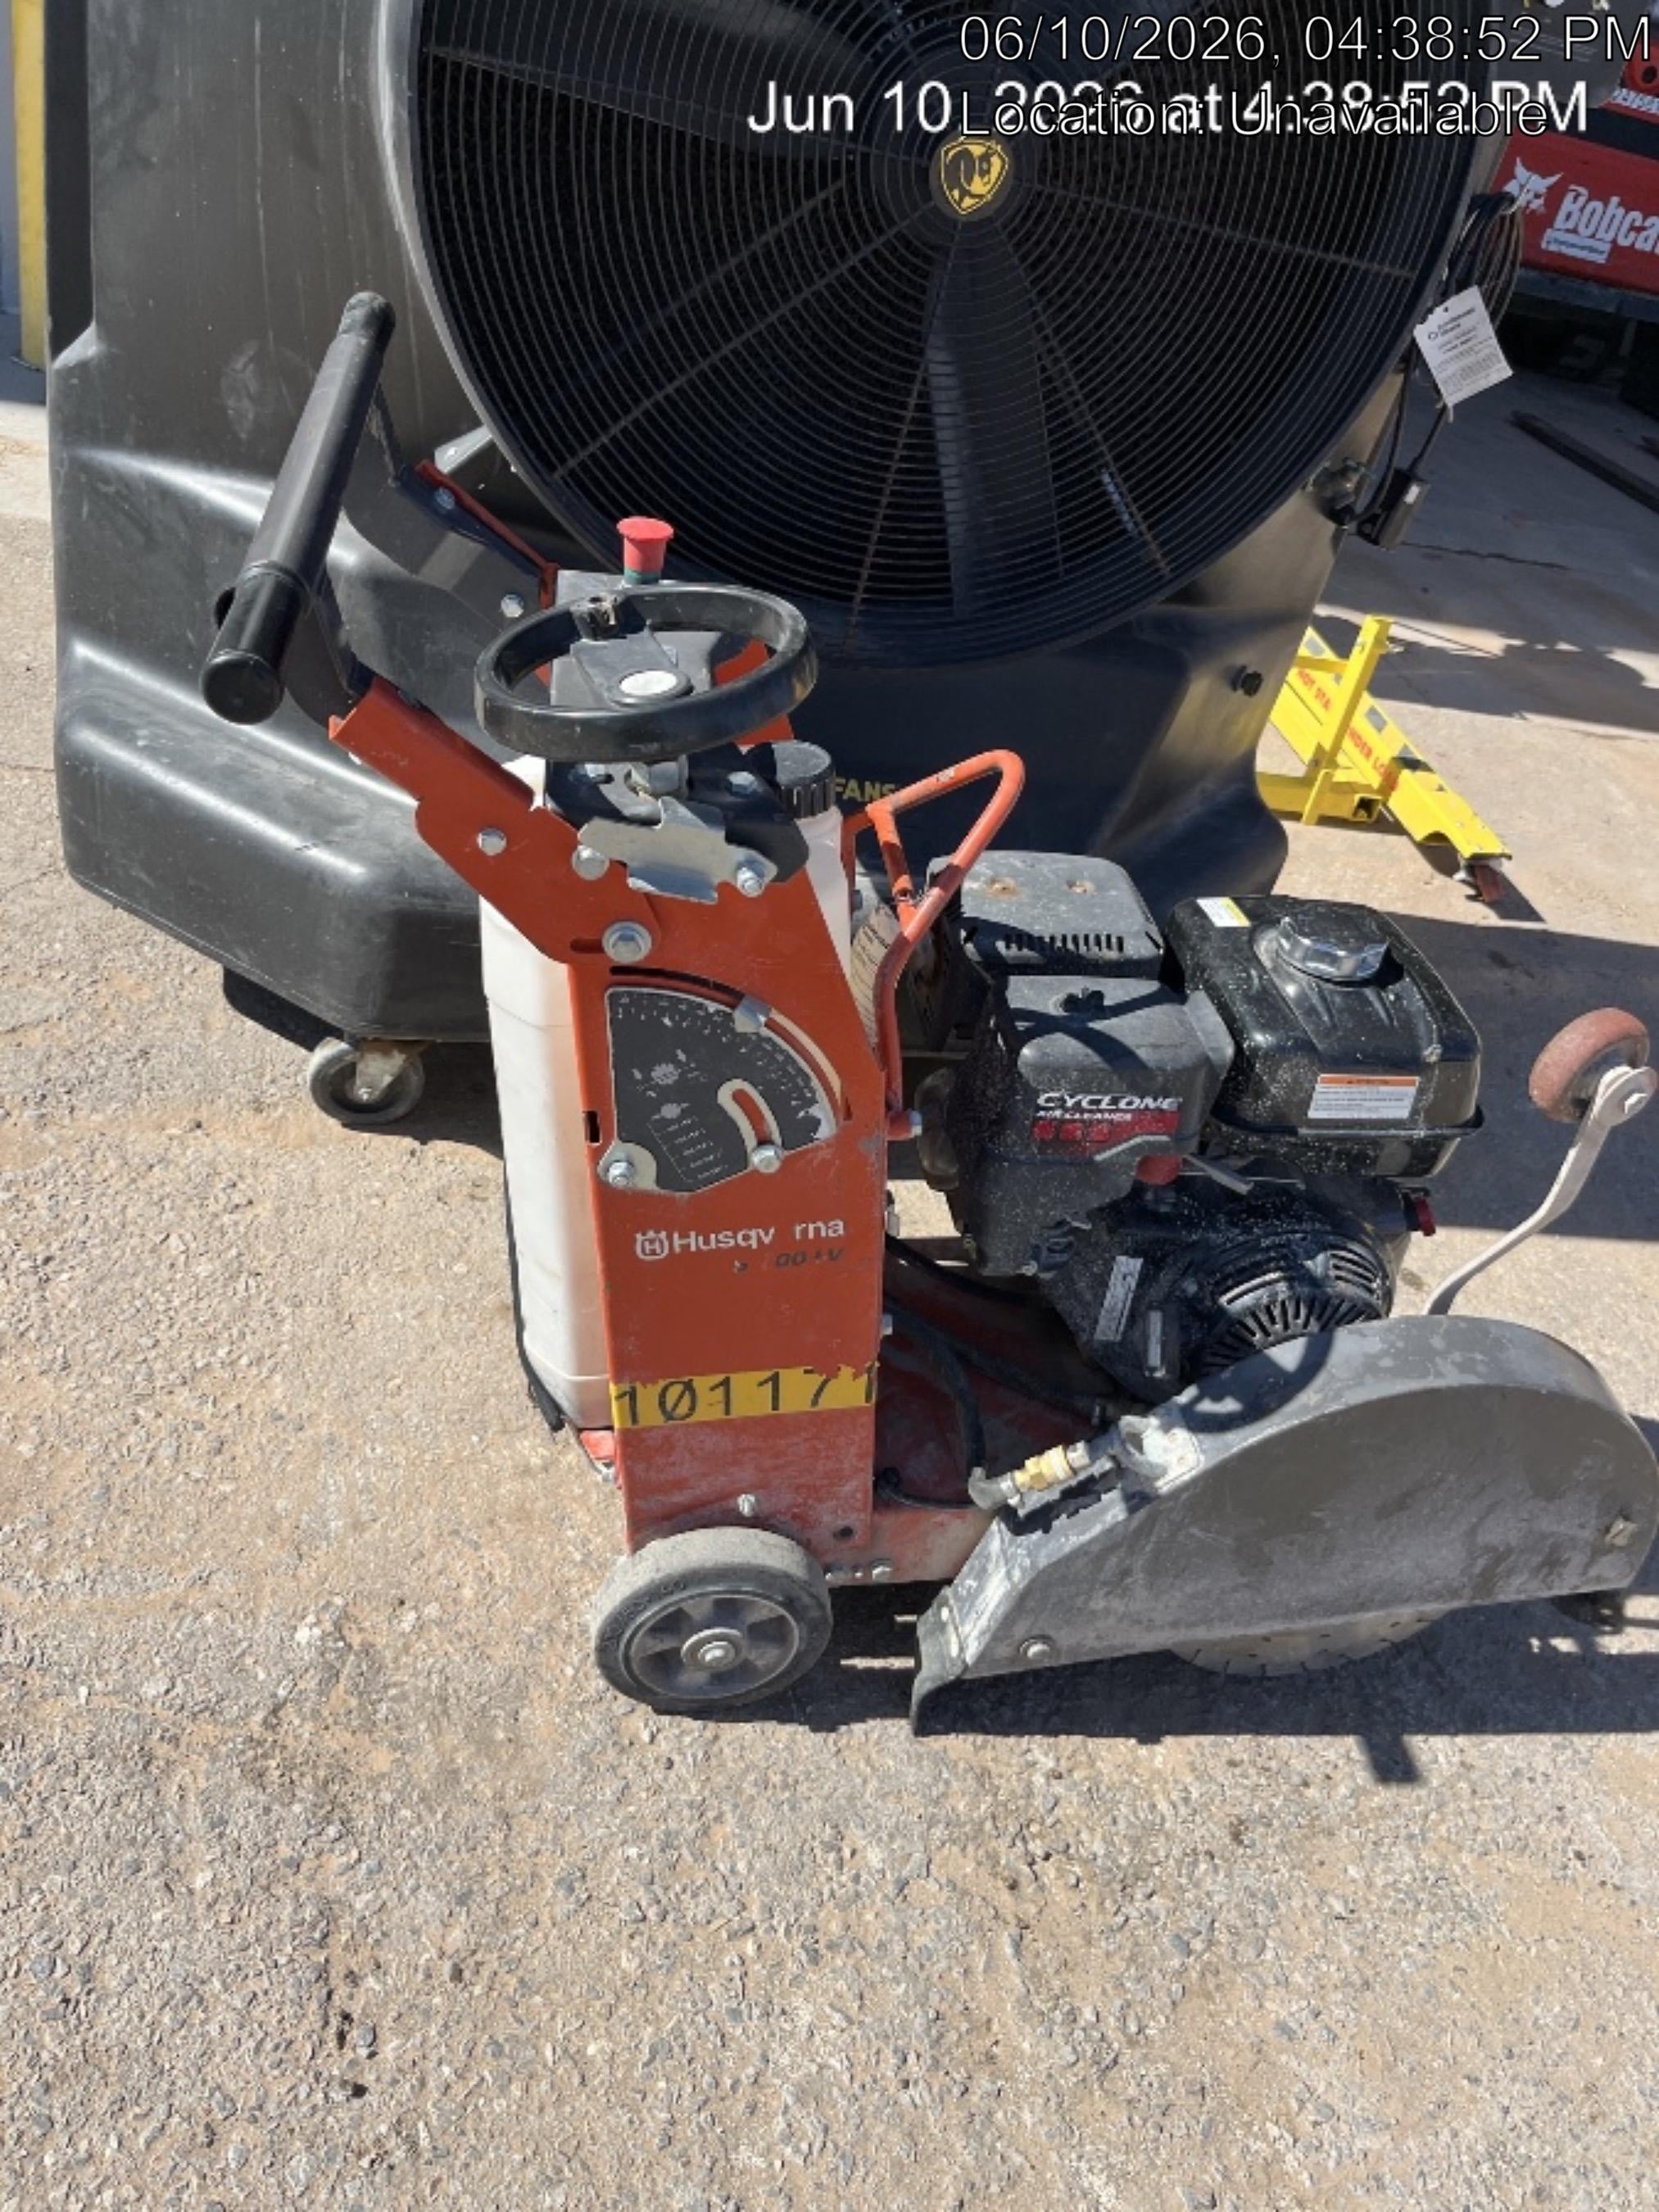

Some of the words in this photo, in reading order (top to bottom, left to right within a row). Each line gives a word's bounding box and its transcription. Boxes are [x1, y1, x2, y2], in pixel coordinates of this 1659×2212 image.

[1554, 184, 1659, 256] Bobca
[1036, 1091, 1180, 1111] CYCLONE
[673, 1218, 845, 1253] Husqvrna
